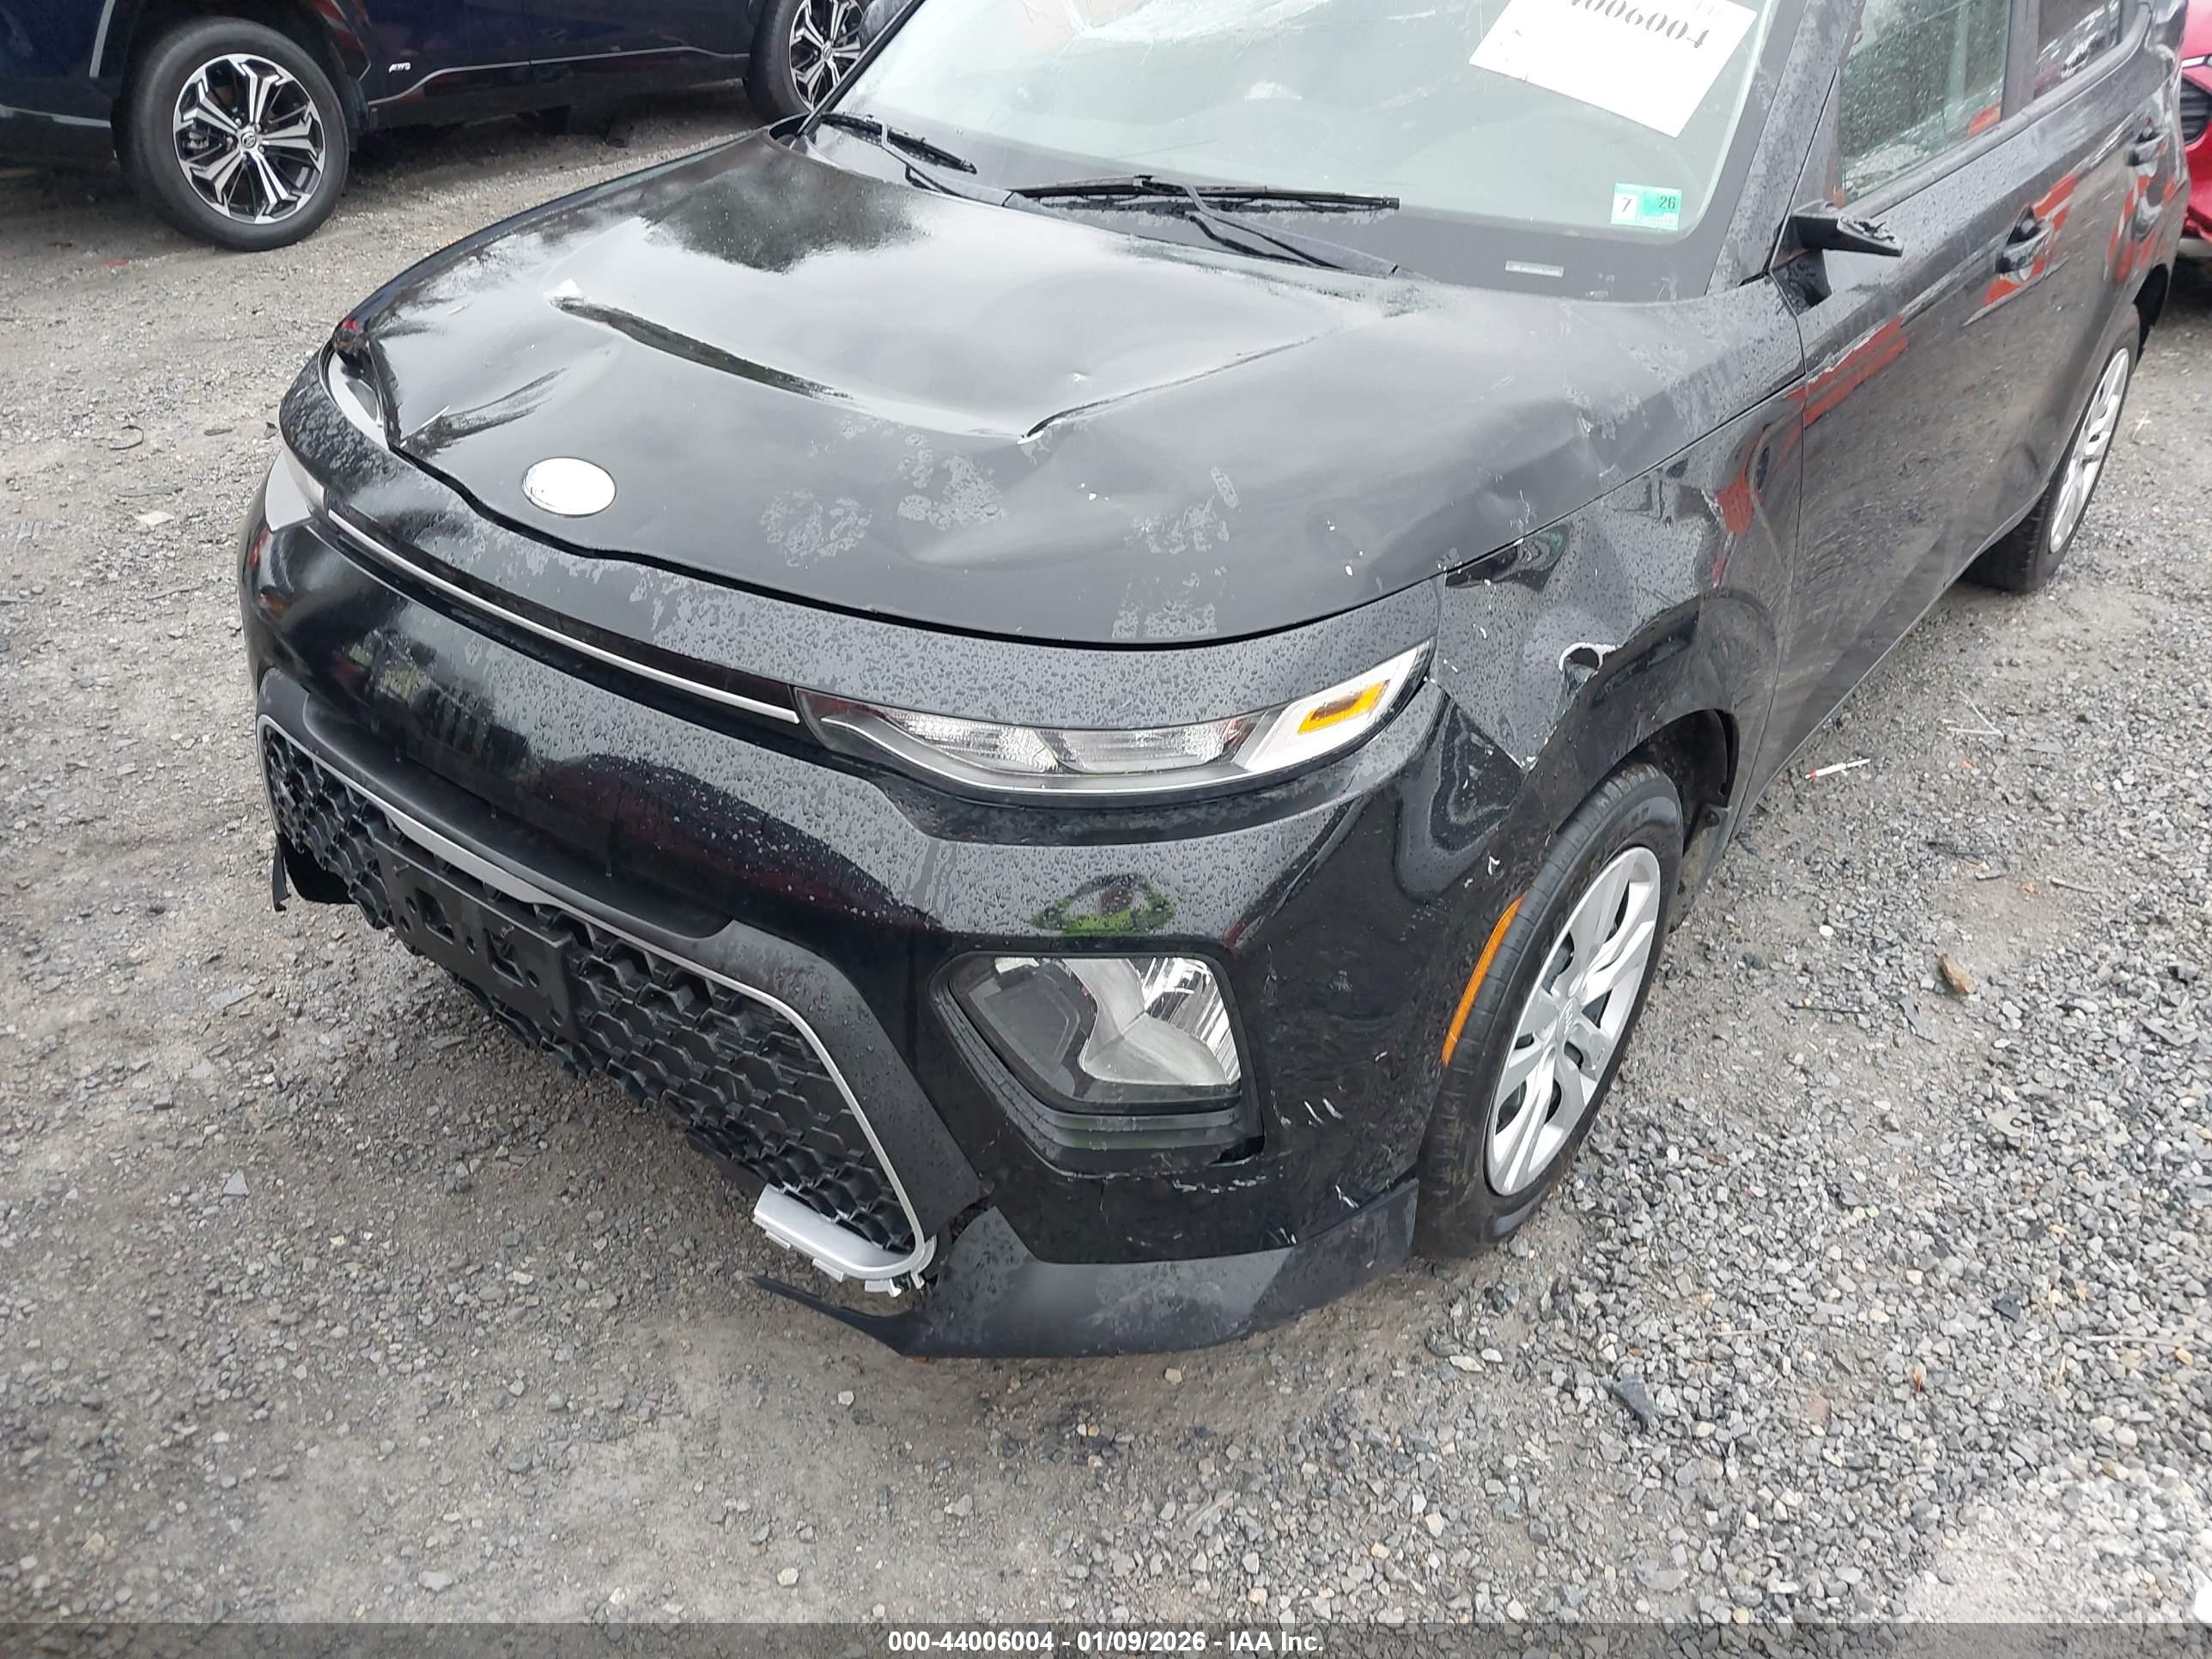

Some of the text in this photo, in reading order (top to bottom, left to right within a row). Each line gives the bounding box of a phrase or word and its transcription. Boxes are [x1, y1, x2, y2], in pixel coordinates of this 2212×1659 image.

[1571, 0, 1710, 48] 006004
[1622, 195, 1676, 213] 7 26
